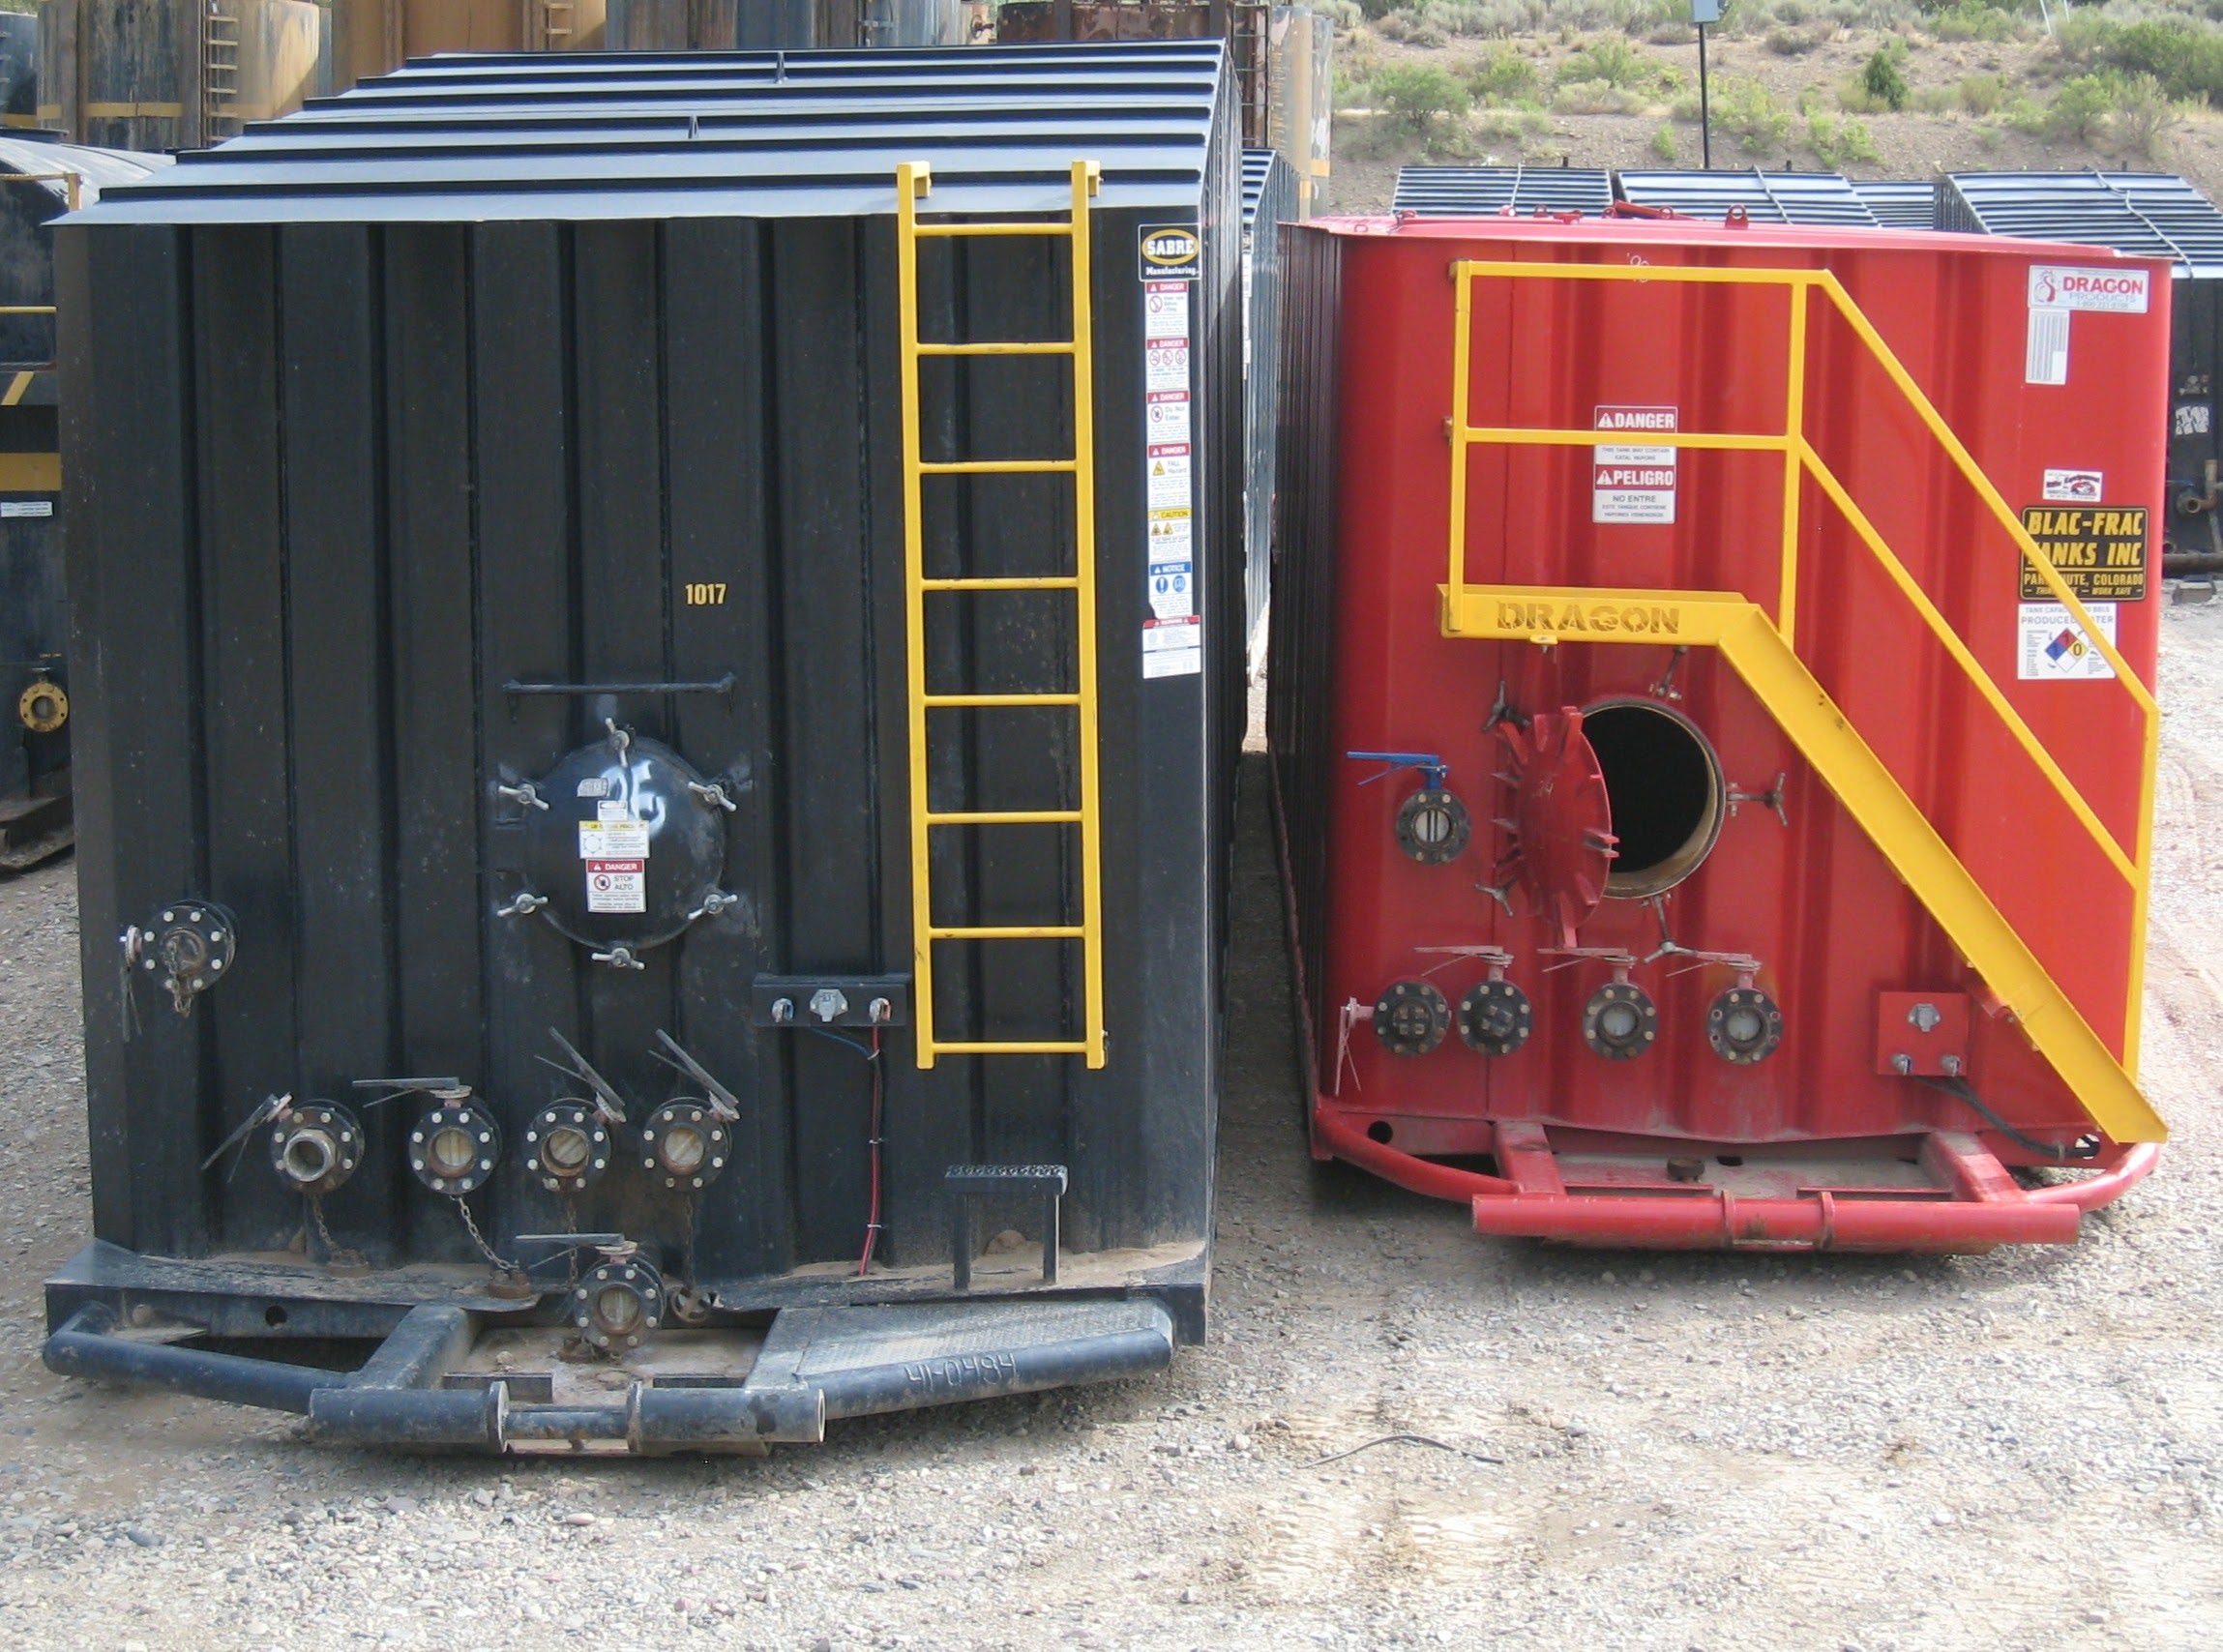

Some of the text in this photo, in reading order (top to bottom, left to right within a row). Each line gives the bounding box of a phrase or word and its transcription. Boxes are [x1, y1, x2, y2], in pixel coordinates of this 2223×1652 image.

[1147, 239, 1195, 255] SABRE
[1160, 282, 1185, 291] DANGER
[2062, 276, 2144, 294] DRAGON
[2068, 292, 2137, 303] PRODUCTS
[1615, 412, 1675, 428] DANGER
[1161, 446, 1187, 455] DANGER
[1614, 470, 1674, 486] PELIGRO
[1161, 510, 1189, 518] CAUTION
[2028, 512, 2144, 536] BLAC-FRAC
[2106, 542, 2142, 566] INC
[1162, 564, 1185, 573] NOTICE
[2093, 573, 2144, 585] COLORADO
[685, 583, 726, 605] 1017
[1497, 601, 1680, 634] DRAGON
[2021, 615, 2077, 624] PRODUCED
[2073, 643, 2082, 656] 0
